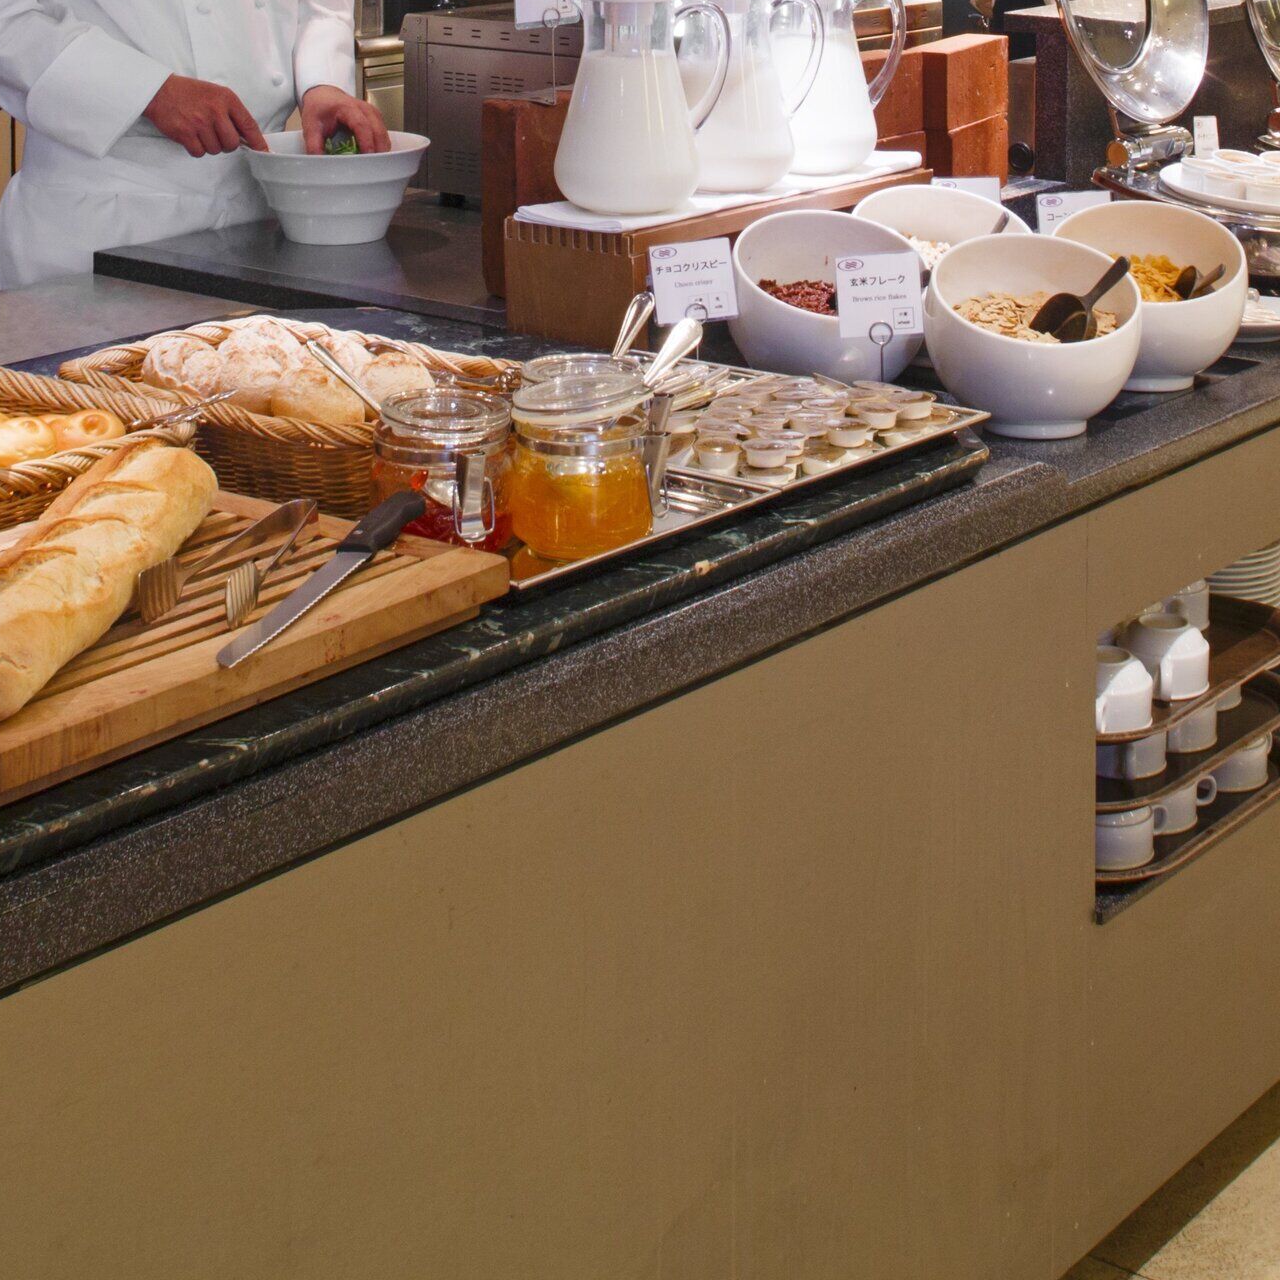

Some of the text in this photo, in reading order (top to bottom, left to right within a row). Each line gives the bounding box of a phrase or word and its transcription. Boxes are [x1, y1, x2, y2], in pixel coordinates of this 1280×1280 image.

[655, 259, 727, 275] チョコクリスピー
[850, 275, 906, 288] 玄米フレーク
